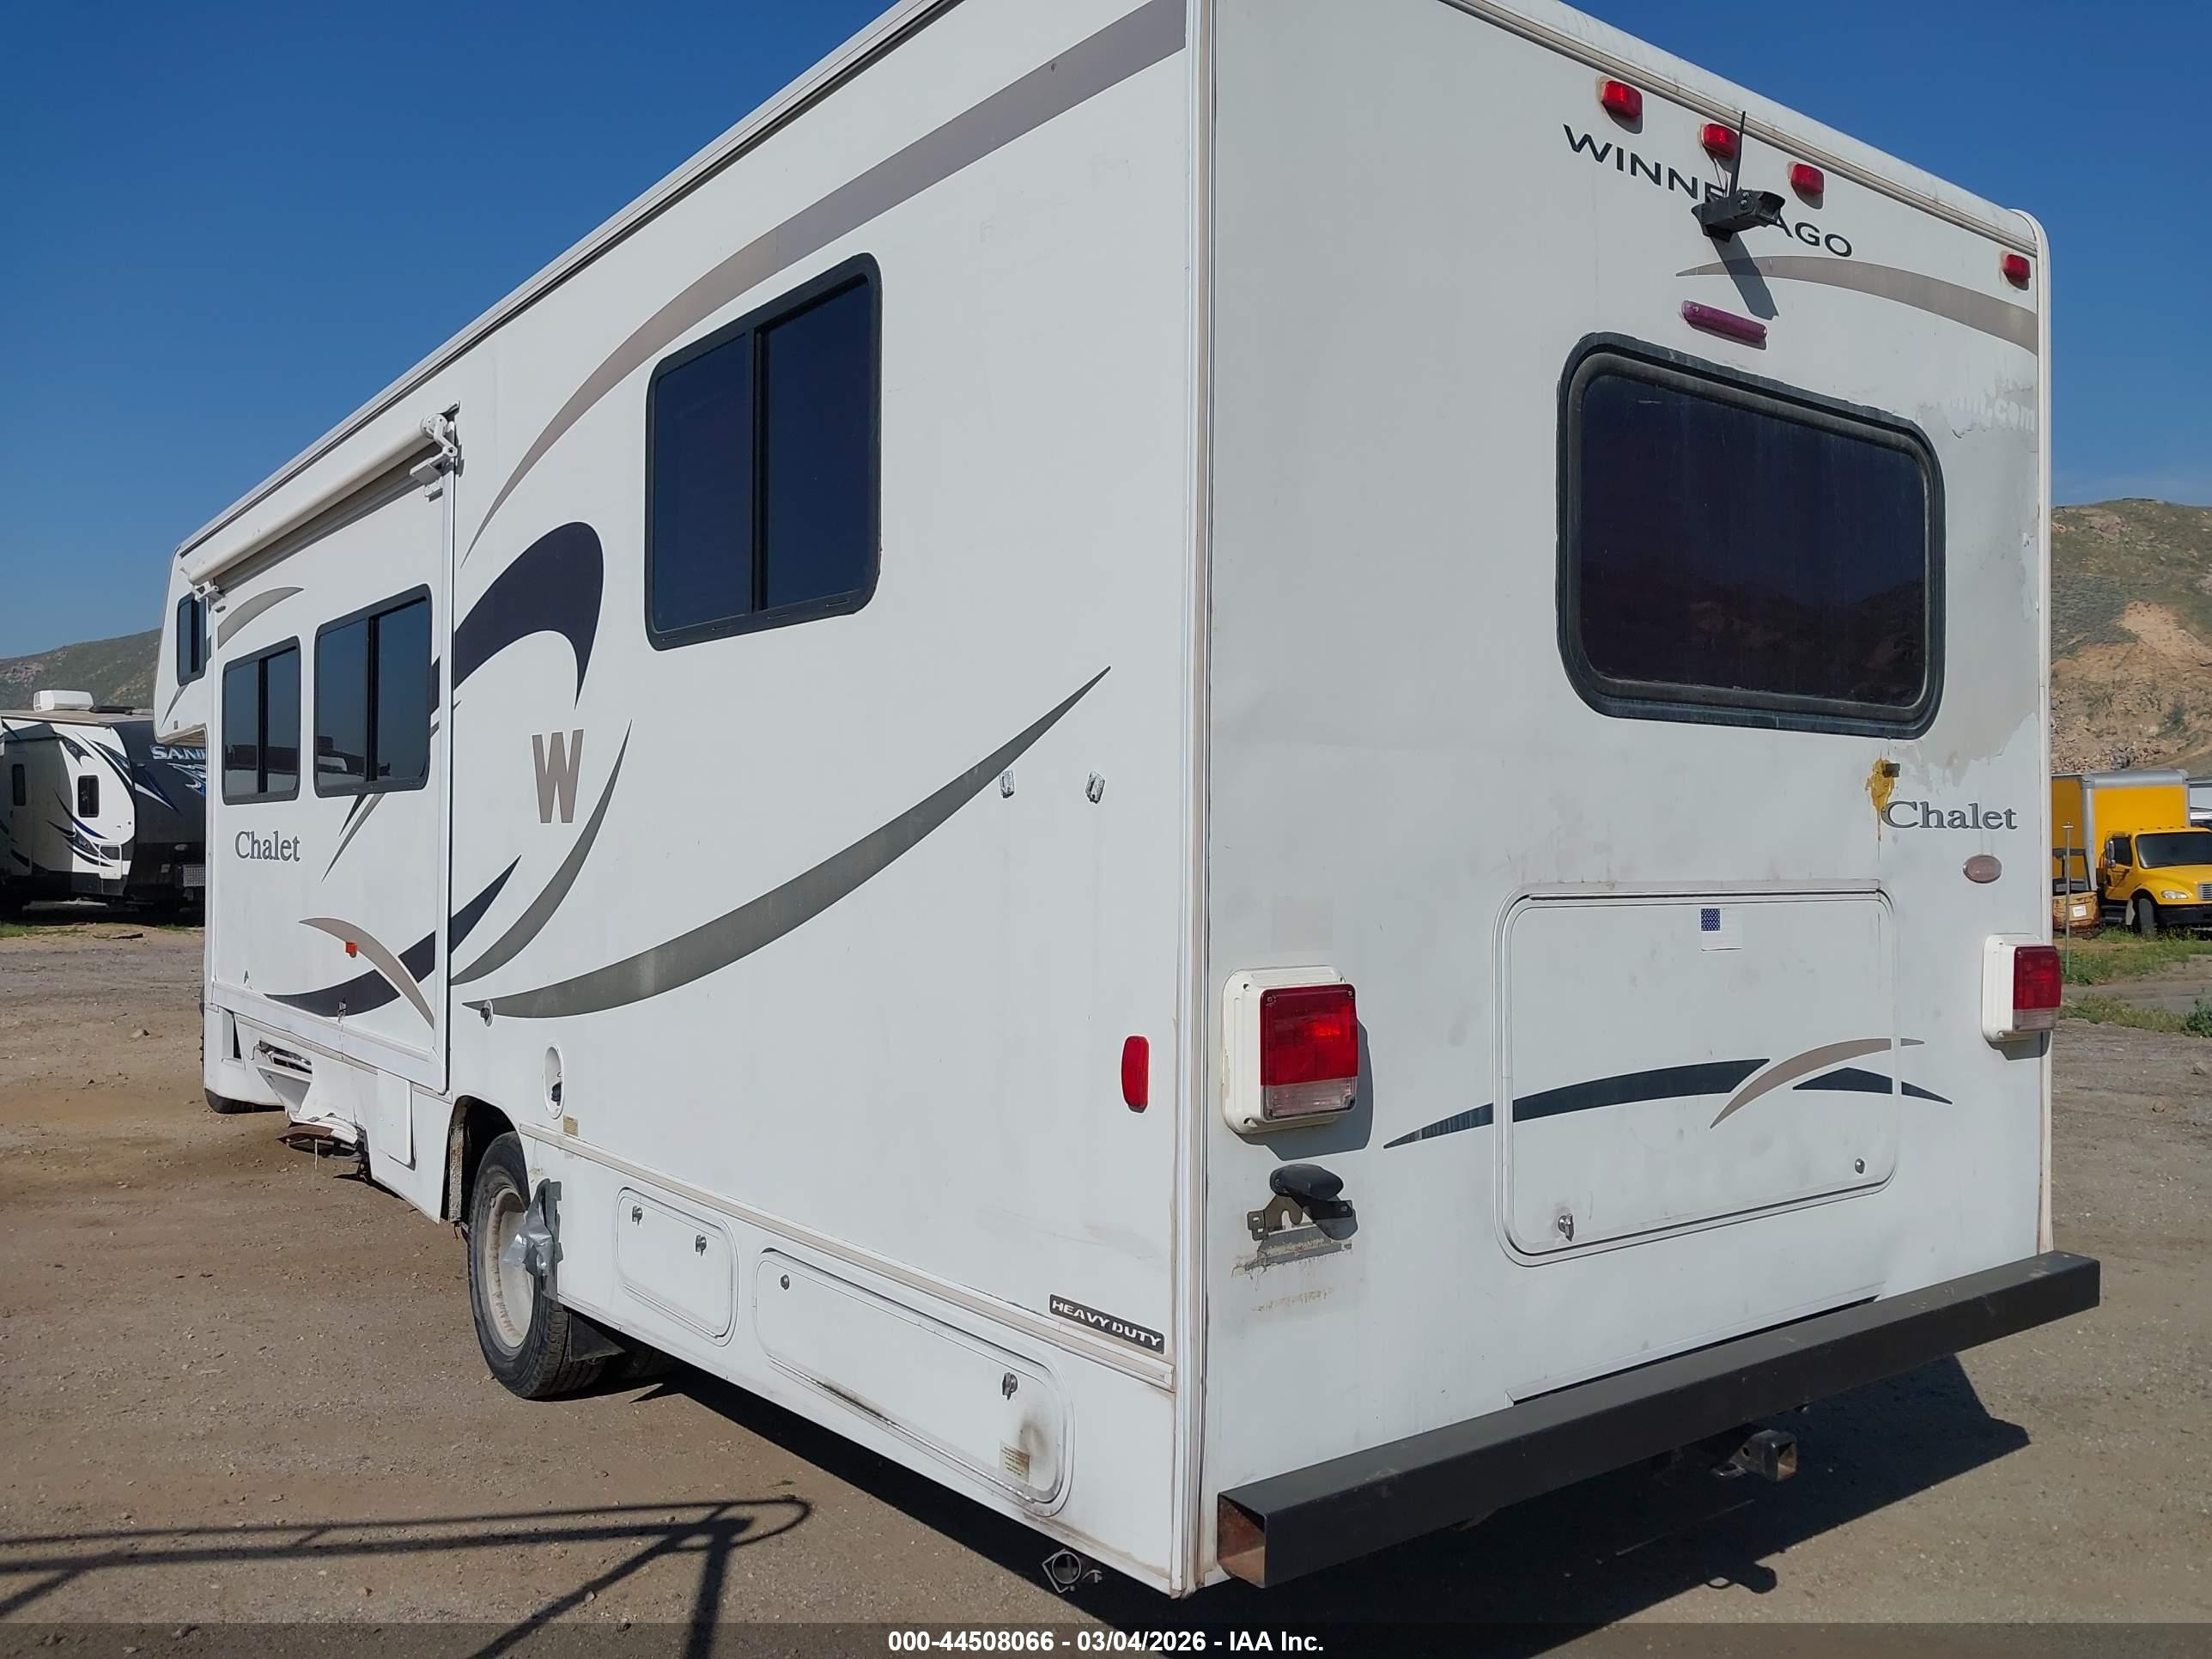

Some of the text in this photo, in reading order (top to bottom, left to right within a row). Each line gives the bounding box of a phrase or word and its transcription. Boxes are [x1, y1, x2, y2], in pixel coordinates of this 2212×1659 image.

[1563, 124, 1852, 258] WINNEAGO
[532, 728, 584, 823] W
[1880, 800, 2018, 830] Chalet
[234, 830, 301, 862] Chalet
[1052, 1300, 1162, 1347] HEAVY DUTY
